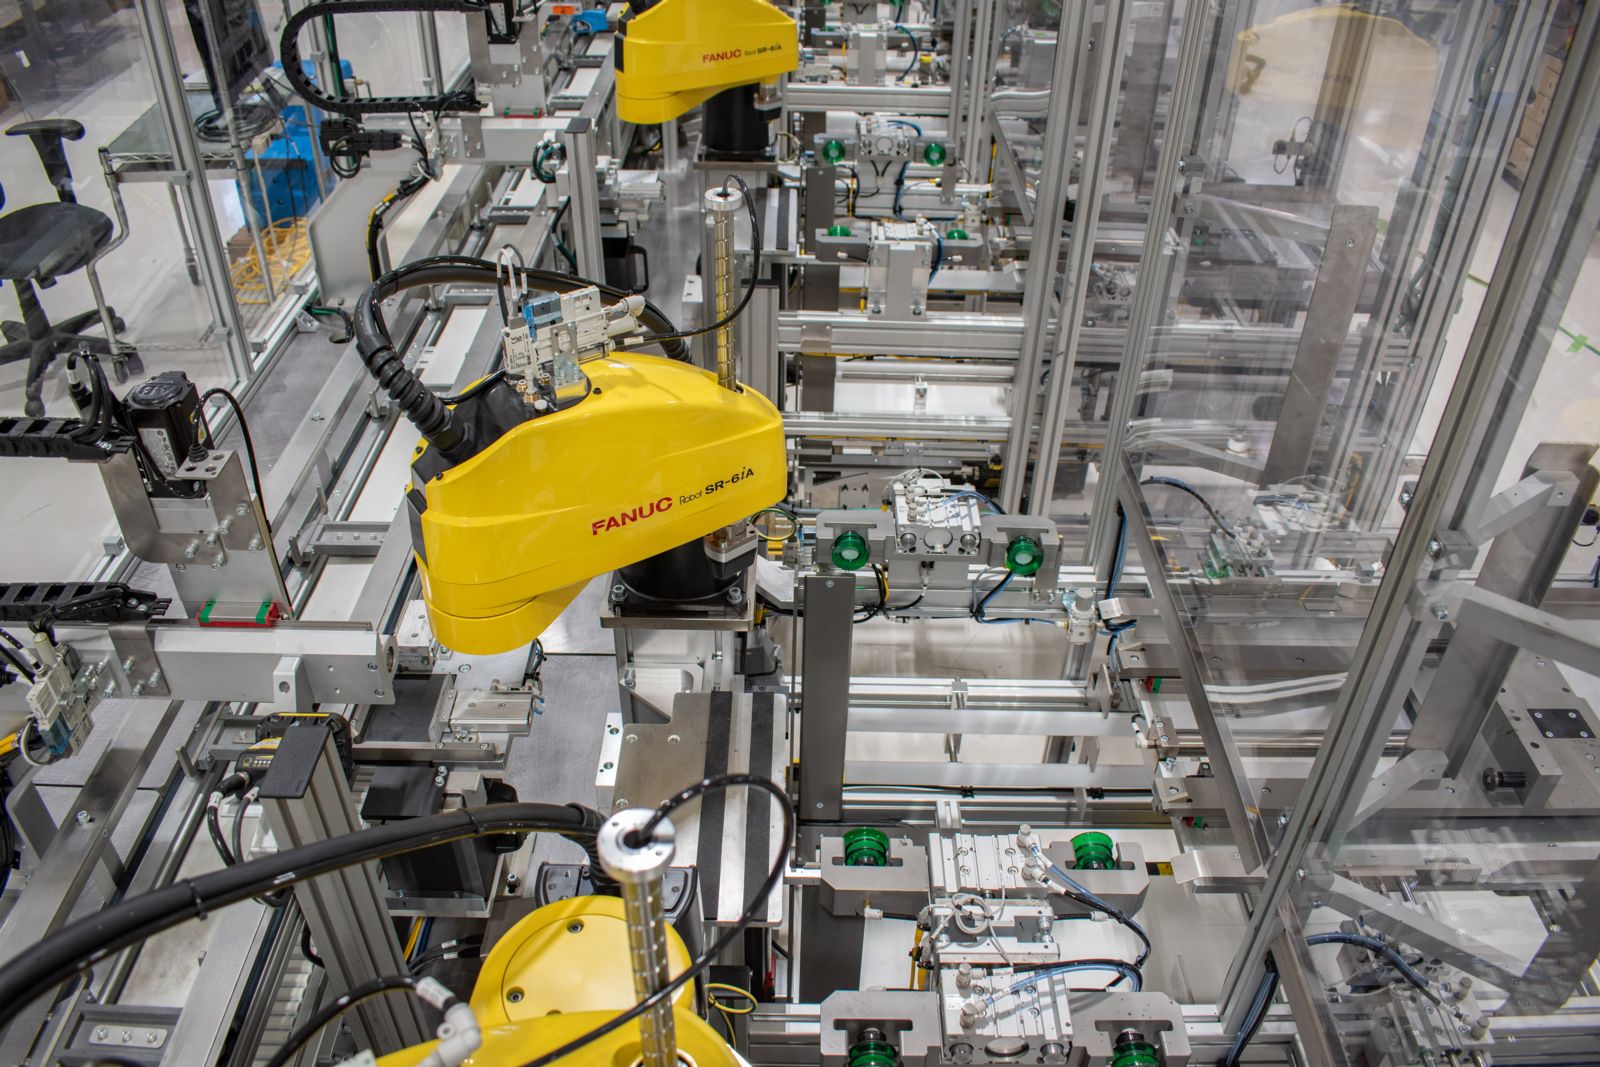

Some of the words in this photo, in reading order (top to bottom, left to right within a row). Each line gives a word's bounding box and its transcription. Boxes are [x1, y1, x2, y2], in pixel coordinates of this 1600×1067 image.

[702, 48, 742, 63] FANUC
[591, 496, 673, 536] FANUC
[679, 490, 703, 505] Robot
[705, 466, 754, 495] SR-6iA
